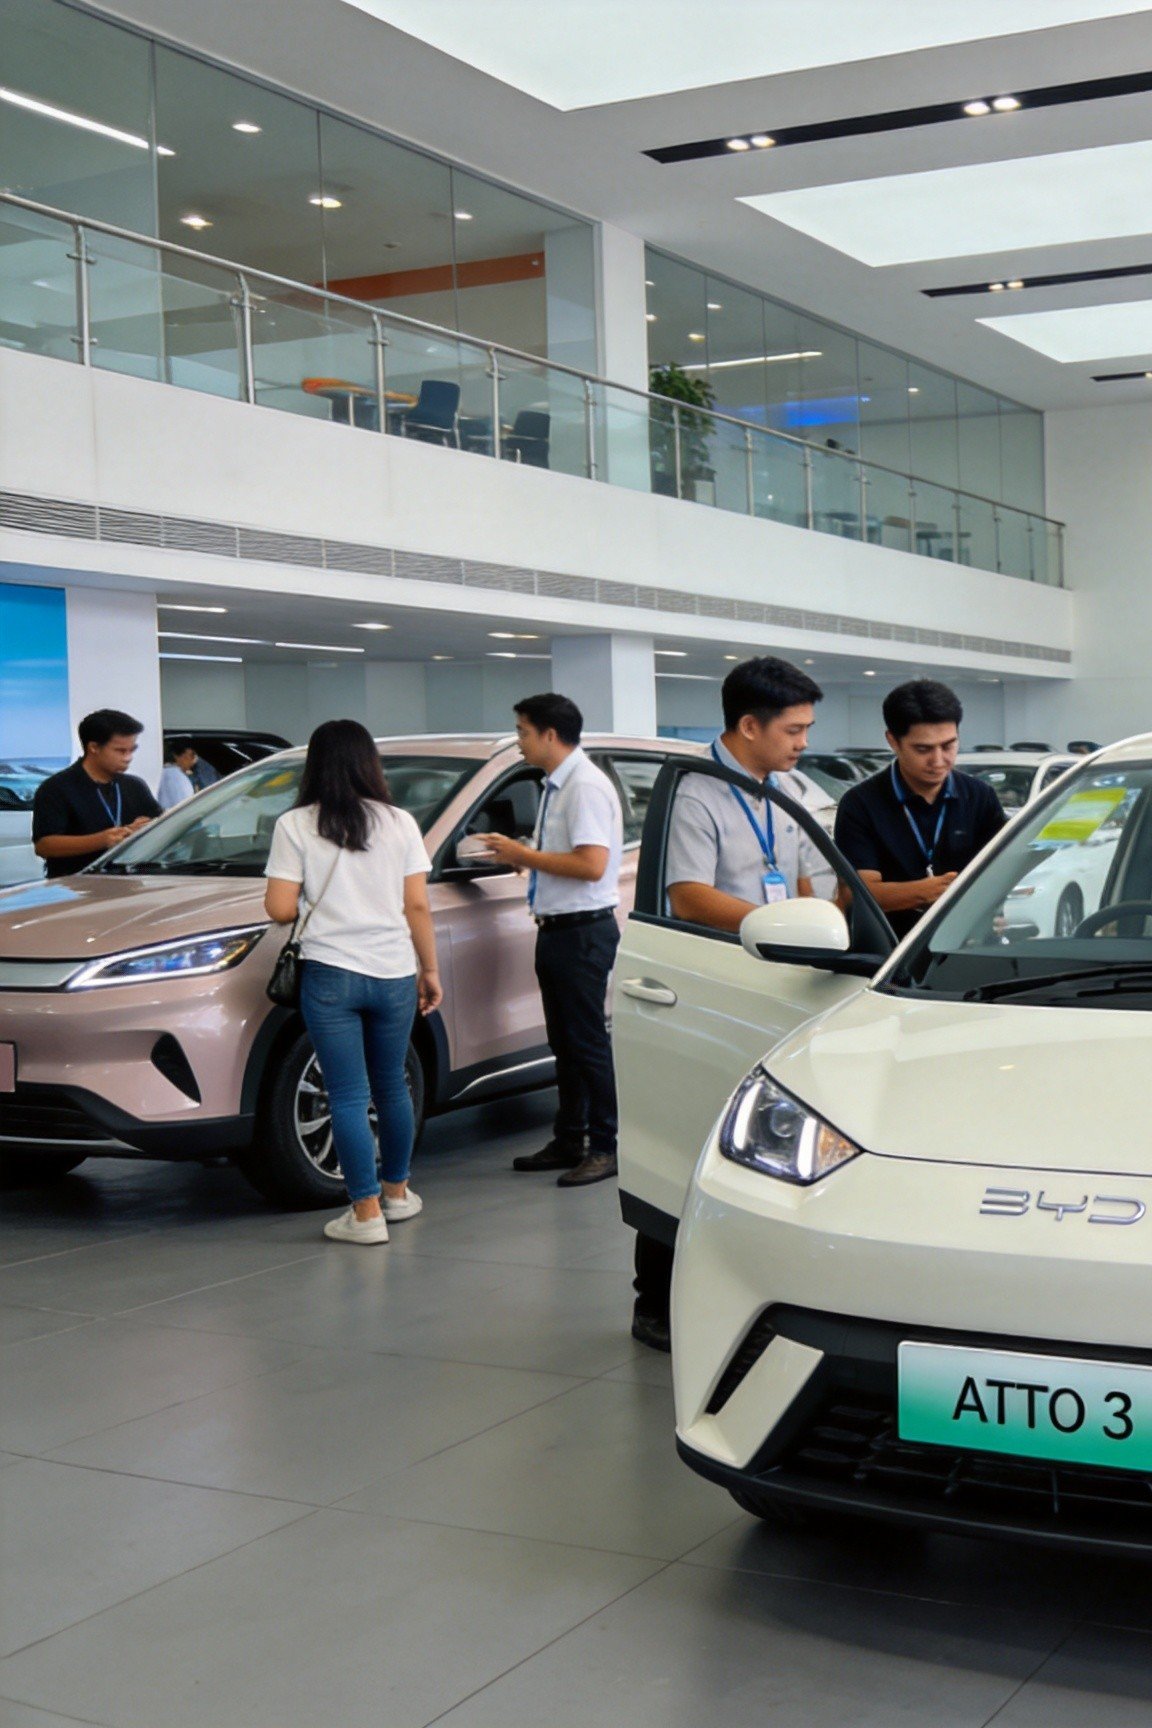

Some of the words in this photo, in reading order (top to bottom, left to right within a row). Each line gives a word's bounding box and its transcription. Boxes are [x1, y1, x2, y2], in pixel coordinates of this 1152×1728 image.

[979, 1187, 1147, 1225] BYD
[952, 1376, 1085, 1433] ATTO
[1102, 1391, 1134, 1440] 3
